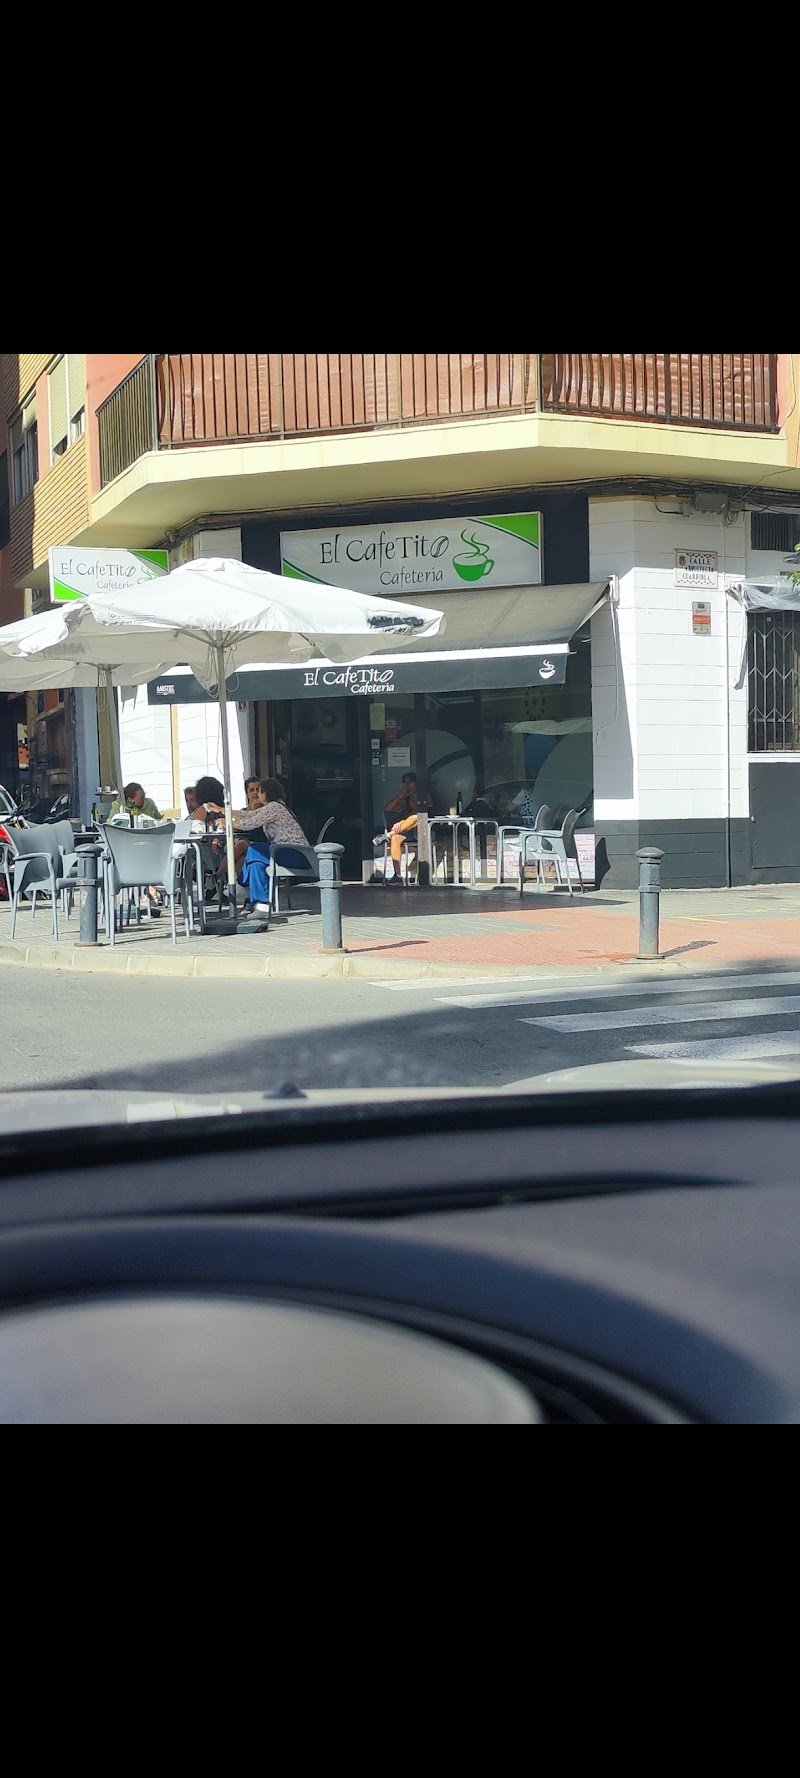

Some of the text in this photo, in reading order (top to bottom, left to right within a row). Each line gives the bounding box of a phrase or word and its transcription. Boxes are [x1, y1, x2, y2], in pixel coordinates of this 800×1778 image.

[320, 533, 341, 565] El
[60, 559, 73, 575] El
[689, 557, 711, 565] CALLE
[304, 668, 321, 686] El
